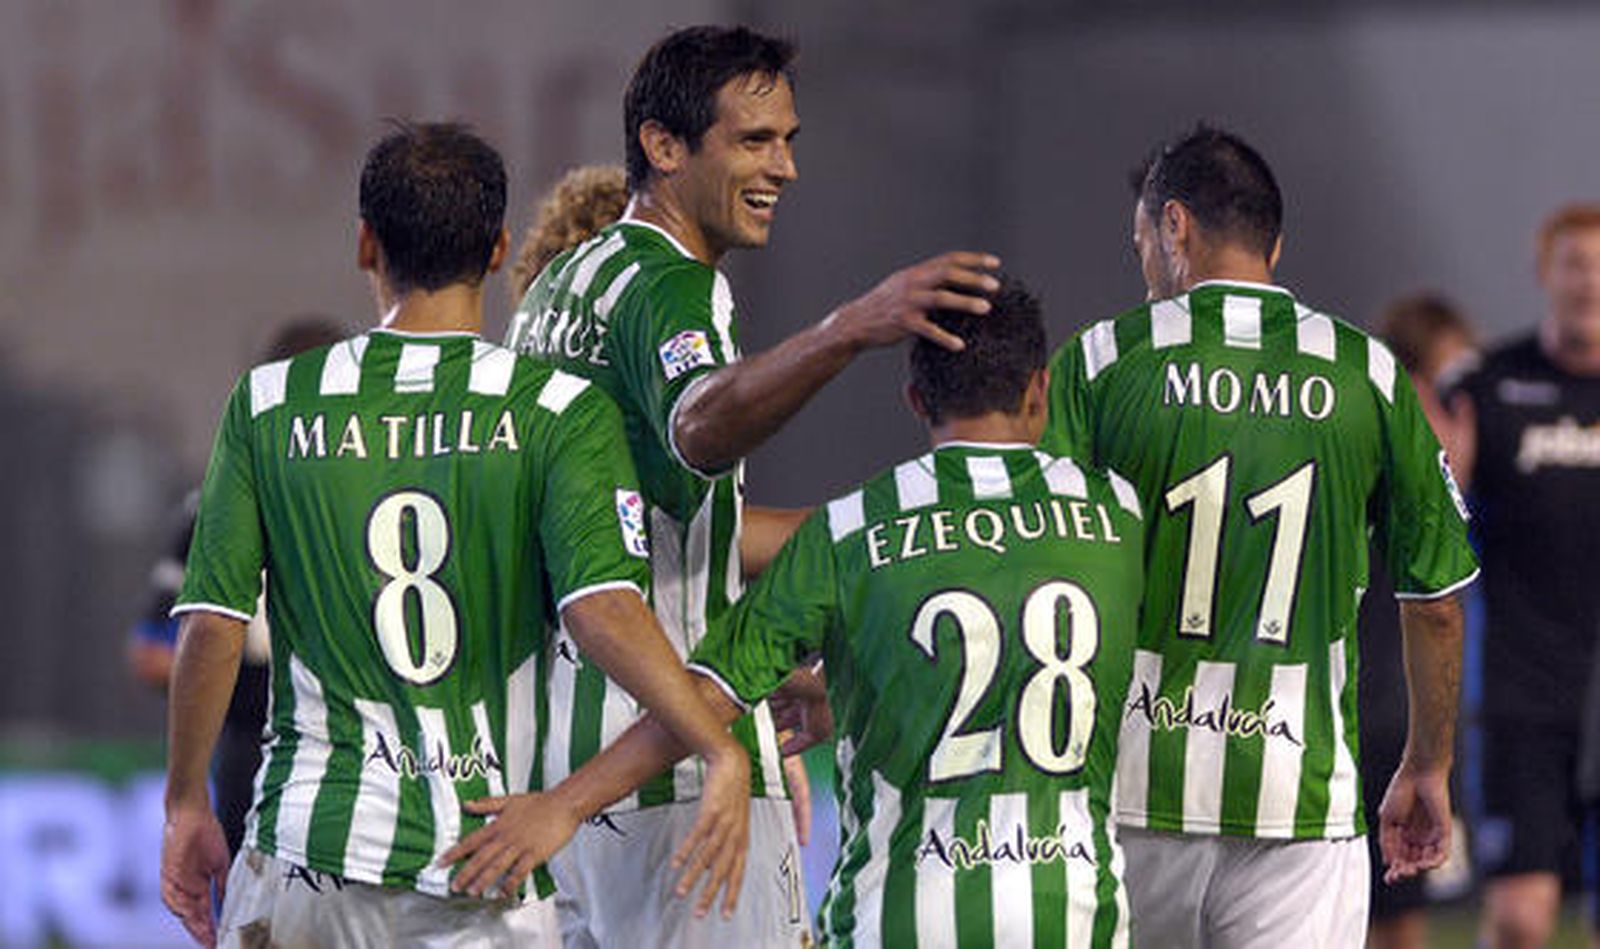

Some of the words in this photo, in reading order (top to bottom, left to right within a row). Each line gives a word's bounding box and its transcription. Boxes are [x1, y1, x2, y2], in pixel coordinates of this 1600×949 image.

[1163, 360, 1336, 421] MOMO
[287, 408, 520, 460] MATILLA
[865, 499, 1122, 569] EZEQUIEL
[1163, 453, 1318, 647] 11
[363, 486, 461, 687] 8
[908, 578, 1101, 783] 28
[1124, 680, 1303, 748] Andalucía
[917, 820, 1097, 870] Andalucía
